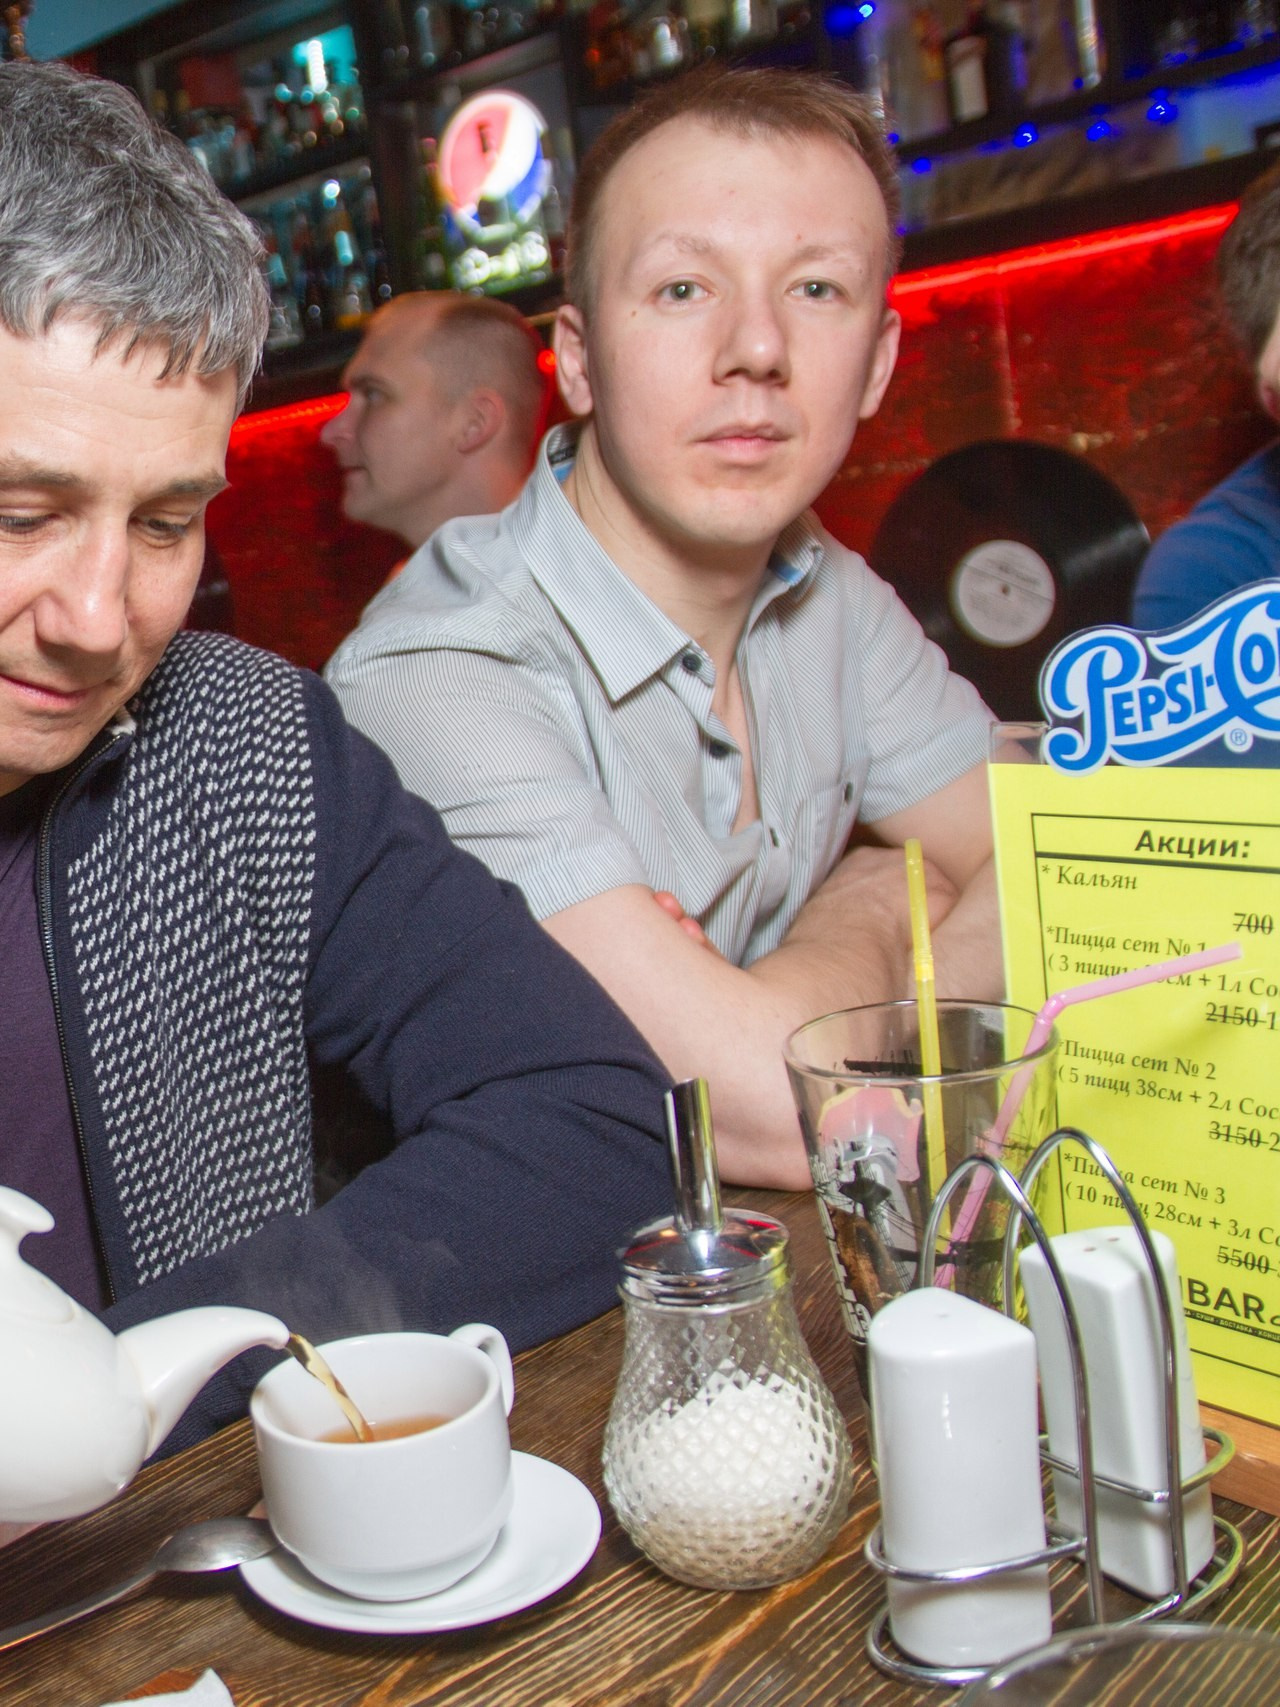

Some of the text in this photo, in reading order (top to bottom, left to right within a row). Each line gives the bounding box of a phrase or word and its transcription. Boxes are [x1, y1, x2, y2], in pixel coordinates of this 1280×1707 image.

[1135, 830, 1250, 858] Акции:
[1056, 864, 1138, 890] Кальян
[1233, 913, 1273, 935] 700
[1122, 938, 1160, 954] сет
[1131, 1055, 1168, 1072] сет
[1174, 1056, 1199, 1077] №
[1205, 1062, 1216, 1080] 2
[1084, 1074, 1130, 1097] пицц
[1135, 1078, 1182, 1103] 38см
[1140, 1175, 1178, 1194] сет
[1184, 1180, 1208, 1200] №
[1214, 1187, 1226, 1205] 3
[1154, 1201, 1202, 1228] 28см
